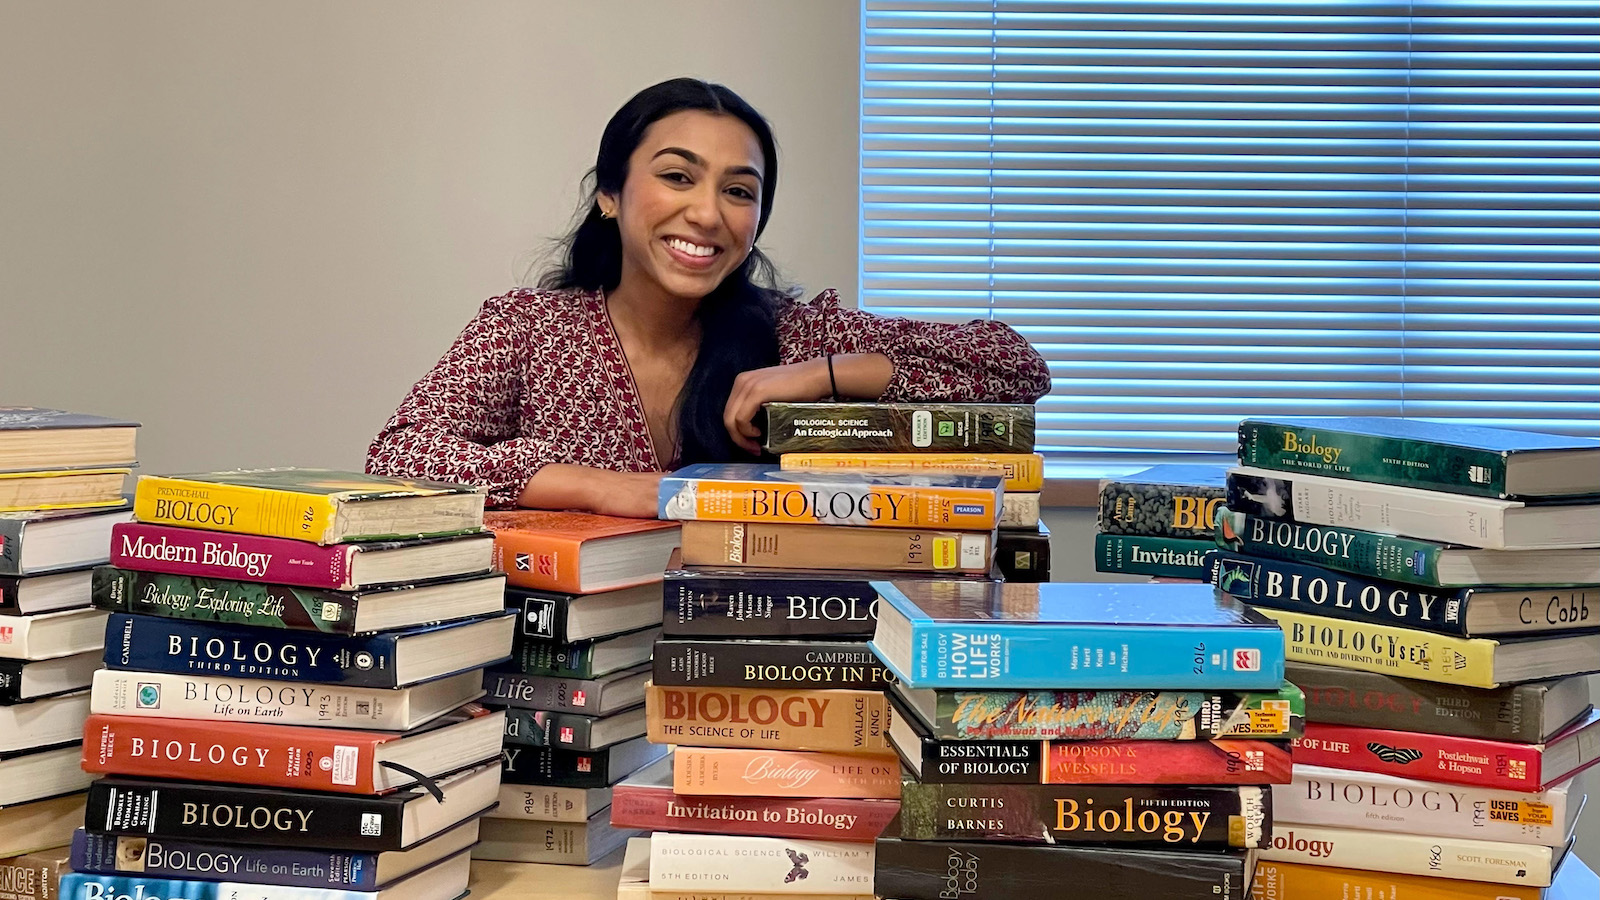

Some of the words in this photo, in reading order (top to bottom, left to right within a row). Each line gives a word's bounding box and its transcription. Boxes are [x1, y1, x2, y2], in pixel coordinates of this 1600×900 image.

[794, 428, 808, 436] An
[808, 428, 851, 438] Ecological
[852, 429, 893, 438] Approach
[1282, 431, 1342, 464] Biology
[1296, 460, 1322, 470] WORLD
[1334, 464, 1351, 472] LIFE
[1402, 460, 1430, 468] EDITION
[157, 487, 210, 500] PRENTICE-HALL
[751, 489, 909, 522] BIOLOGY
[154, 499, 239, 526] BIOLOGY
[301, 506, 314, 534] 1986
[956, 506, 982, 514] PEARSON
[730, 523, 744, 564] Biology
[908, 534, 923, 564] 1986
[1252, 518, 1356, 559] BIOLOGY
[120, 534, 198, 565] Modern
[202, 542, 272, 577] Biology
[1376, 537, 1384, 576] CAMPBELL
[141, 582, 192, 612] Biology:
[194, 588, 254, 618] Exploring
[257, 594, 286, 617] Life
[736, 592, 744, 622] Johnson
[754, 596, 762, 616] Losos
[764, 596, 773, 618] Singer
[1266, 571, 1439, 622] BIOLOGY
[1518, 597, 1538, 624] C.
[1546, 592, 1589, 625] Cobb
[1446, 600, 1459, 622] WCB
[122, 618, 134, 665] CAMPBELL
[168, 634, 320, 667] BIOLOGY
[1292, 622, 1400, 655] BIOLOGY
[806, 652, 876, 664] CAMPBELL
[938, 632, 948, 678] BIOLOGY
[952, 633, 968, 678] HOW
[970, 634, 988, 678] LIFE
[990, 634, 1001, 678] WORKS
[1070, 646, 1078, 670] Morris
[1096, 648, 1104, 668] Knoll
[1108, 651, 1116, 665] Lue
[1194, 642, 1206, 675] 2016
[1306, 648, 1324, 657] UNITY
[1327, 651, 1339, 659] AND
[1340, 653, 1373, 664] DIVERSITY
[1386, 659, 1399, 668] LIFE
[188, 660, 231, 672] THIRD
[240, 664, 299, 678] EDITION
[744, 664, 834, 682] BIOLOGY
[842, 666, 864, 682] IN
[184, 682, 316, 706] BIOLOGY
[494, 677, 534, 700] Life
[214, 704, 236, 717] Life
[238, 708, 250, 716] on
[254, 706, 284, 718] Earth
[318, 694, 332, 720] 1993
[663, 690, 831, 728] BIOLOGY
[952, 695, 1006, 724] The
[1005, 694, 1103, 725] Nature
[1108, 696, 1142, 734] of
[1200, 700, 1211, 730] THIRD
[1211, 696, 1222, 734] EDITION
[1436, 697, 1470, 708] THIRD
[1436, 708, 1481, 719] EDITION
[1512, 693, 1522, 734] WORTH
[663, 724, 684, 736] THE
[690, 726, 735, 738] SCIENCE
[740, 728, 755, 739] OF
[760, 730, 780, 740] LIFE
[854, 697, 864, 747] WALLACE
[870, 708, 880, 737] KING
[99, 724, 109, 765] CAMPBELL
[107, 732, 116, 758] REECE
[130, 737, 270, 768] BIOLOGY
[940, 746, 1030, 758] ESSENTIALS
[1058, 746, 1122, 758] HOPSON
[1126, 746, 1136, 758] &
[1304, 738, 1320, 750] OF
[1322, 740, 1350, 754] LIFE
[286, 746, 294, 778] Seventh
[293, 748, 301, 777] Edition
[832, 765, 863, 775] LIFE
[871, 766, 891, 776] ON
[938, 762, 960, 774] OF
[964, 762, 1030, 774] BIOLOGY
[1058, 763, 1136, 774] WESSELLS
[1438, 750, 1490, 766] Postlethwait
[1438, 761, 1447, 770] &
[1449, 762, 1482, 775] Hopson
[742, 755, 820, 788] Biology
[524, 791, 534, 815] 1984
[947, 798, 1004, 808] CURTIS
[1140, 799, 1168, 807] FIFTH
[1170, 800, 1211, 808] EDITION
[1306, 780, 1467, 813] BIOLOGY
[1490, 800, 1518, 811] USED
[114, 794, 124, 826] BROOKER
[122, 791, 134, 830] WIDMAIER
[131, 794, 142, 827] GRAHAM
[140, 796, 150, 826] STILING
[182, 802, 314, 832] BIOLOGY
[666, 800, 758, 822] Invitation
[762, 808, 781, 822] to
[785, 807, 858, 830] Biology
[1054, 797, 1211, 843] Biology
[1246, 796, 1254, 840] WORTH
[1366, 811, 1380, 820] fifth
[1381, 814, 1405, 822] edition
[1490, 810, 1520, 822] SAVES
[947, 819, 1004, 830] BARNES
[546, 828, 554, 852] 1972
[662, 848, 730, 857] BIOLOGICAL
[734, 849, 782, 858] SCIENCE
[1270, 832, 1334, 858] ology
[148, 842, 244, 874] BIOLOGY
[246, 859, 268, 874] Life
[272, 864, 288, 874] on
[292, 862, 324, 878] Earth
[812, 850, 862, 858] WILLIAM
[1430, 845, 1442, 870] 1980
[1484, 857, 1527, 868] FORESMAN
[328, 854, 336, 883] Seventh
[661, 872, 682, 881] 5TH
[684, 873, 730, 881] EDITION
[833, 875, 869, 884] JAMES
[940, 846, 964, 900] Biology
[958, 852, 981, 894] Today
